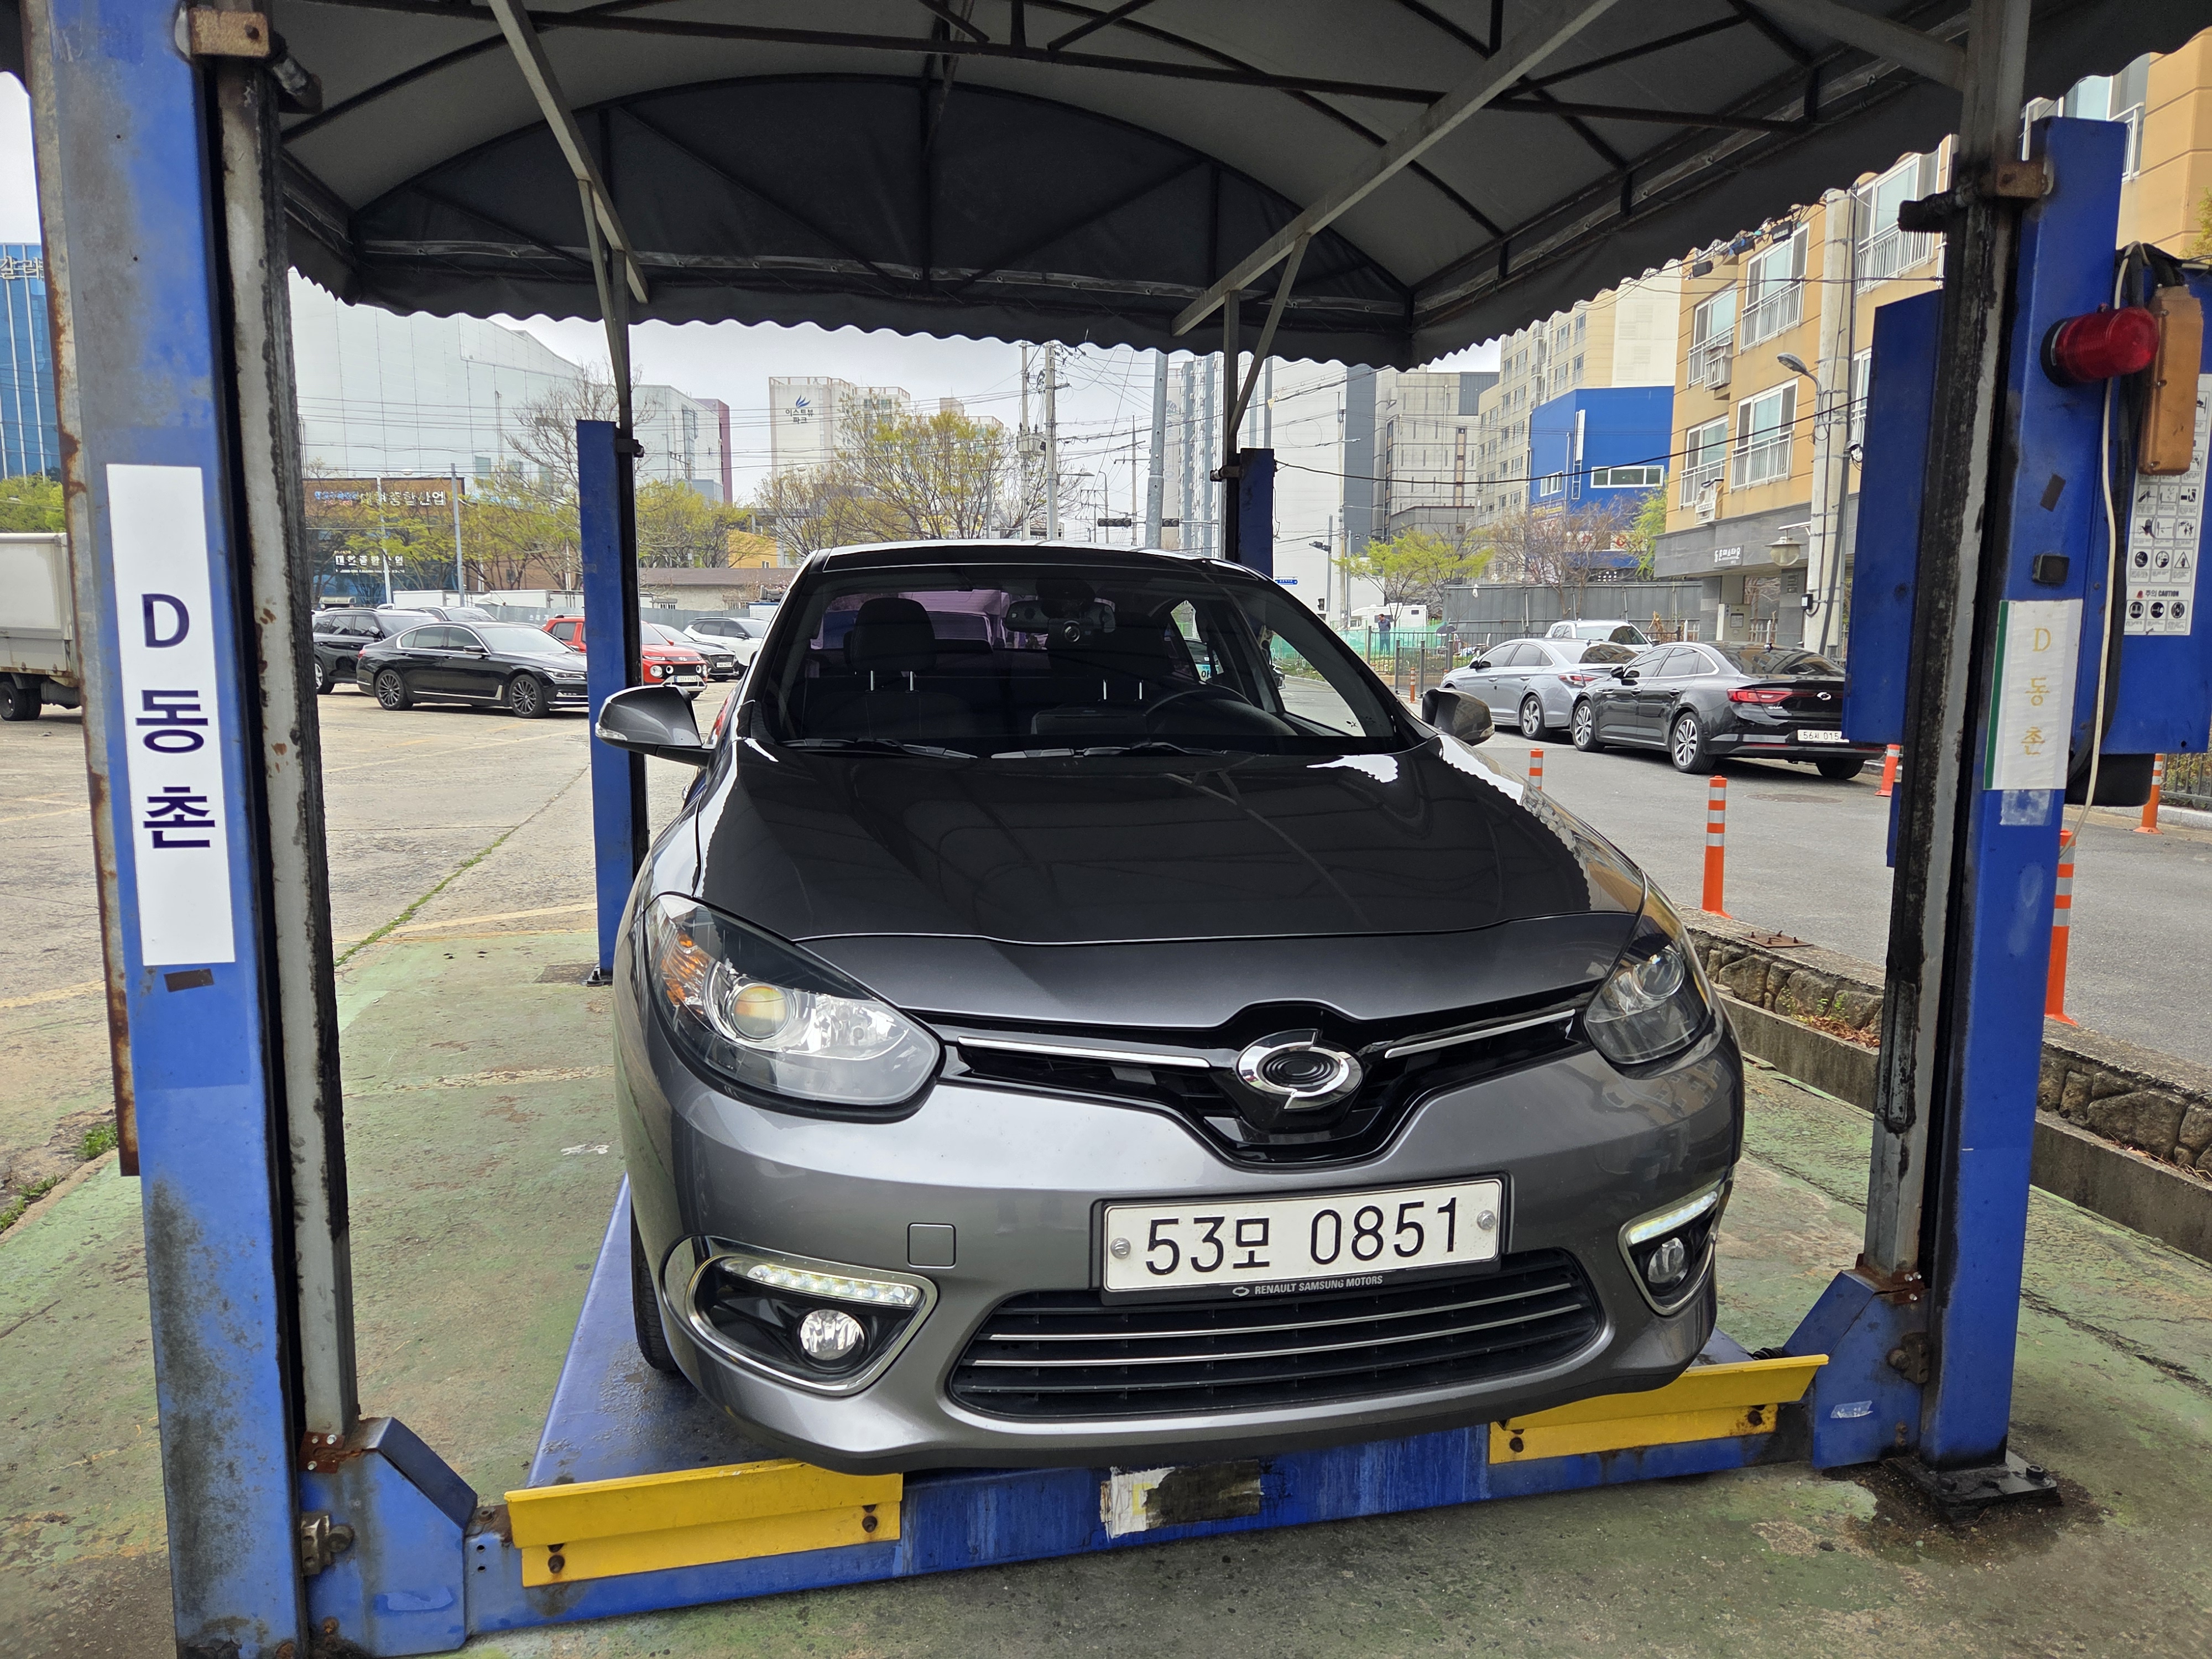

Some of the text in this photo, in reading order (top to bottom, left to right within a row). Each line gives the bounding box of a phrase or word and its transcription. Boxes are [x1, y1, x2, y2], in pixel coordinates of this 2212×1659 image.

[785, 409, 814, 417] 이스트뷰
[1823, 732, 1840, 740] 015
[1145, 1197, 1458, 1275] 53모 0851
[1254, 1275, 1384, 1295] RENAULT SAMSUNG MOTORS
